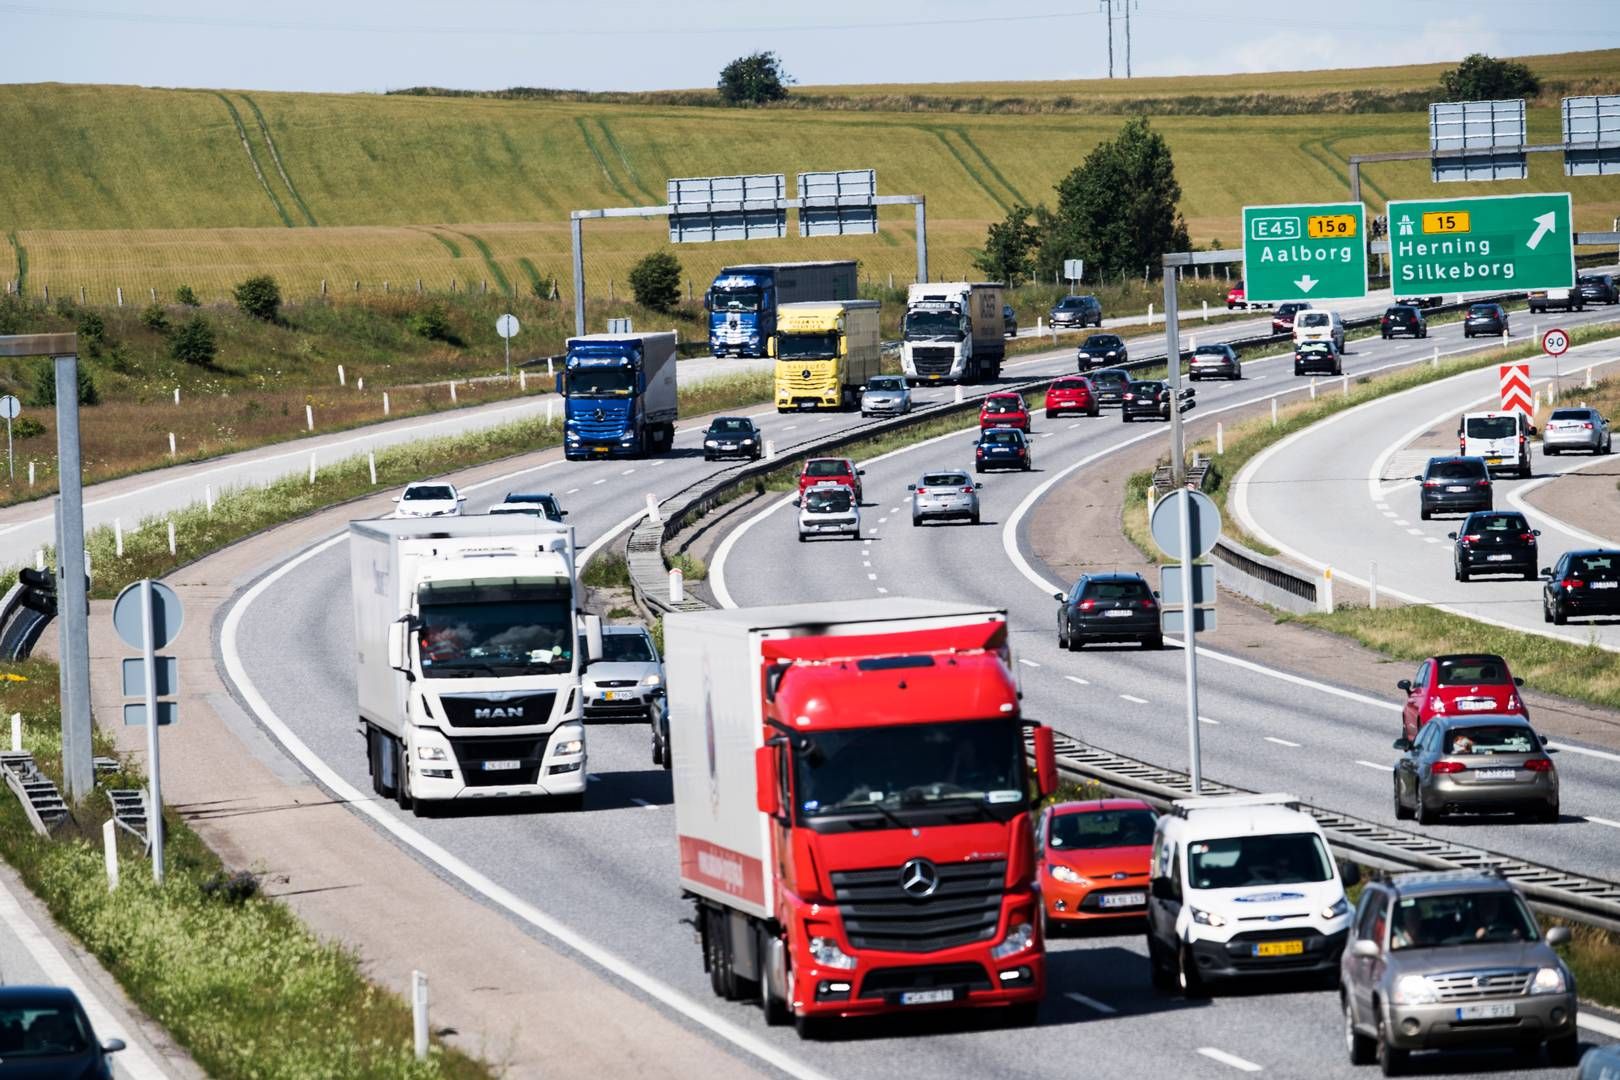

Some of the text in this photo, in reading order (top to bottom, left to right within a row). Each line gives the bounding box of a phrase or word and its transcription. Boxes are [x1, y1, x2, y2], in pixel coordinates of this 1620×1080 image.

[1258, 221, 1295, 236] E45
[1437, 216, 1456, 229] 15
[1260, 245, 1351, 263] Aalborg
[1399, 238, 1490, 256] Herning
[1402, 262, 1514, 280] Silkeborg
[1548, 337, 1564, 347] 90
[475, 706, 524, 719] MAN
